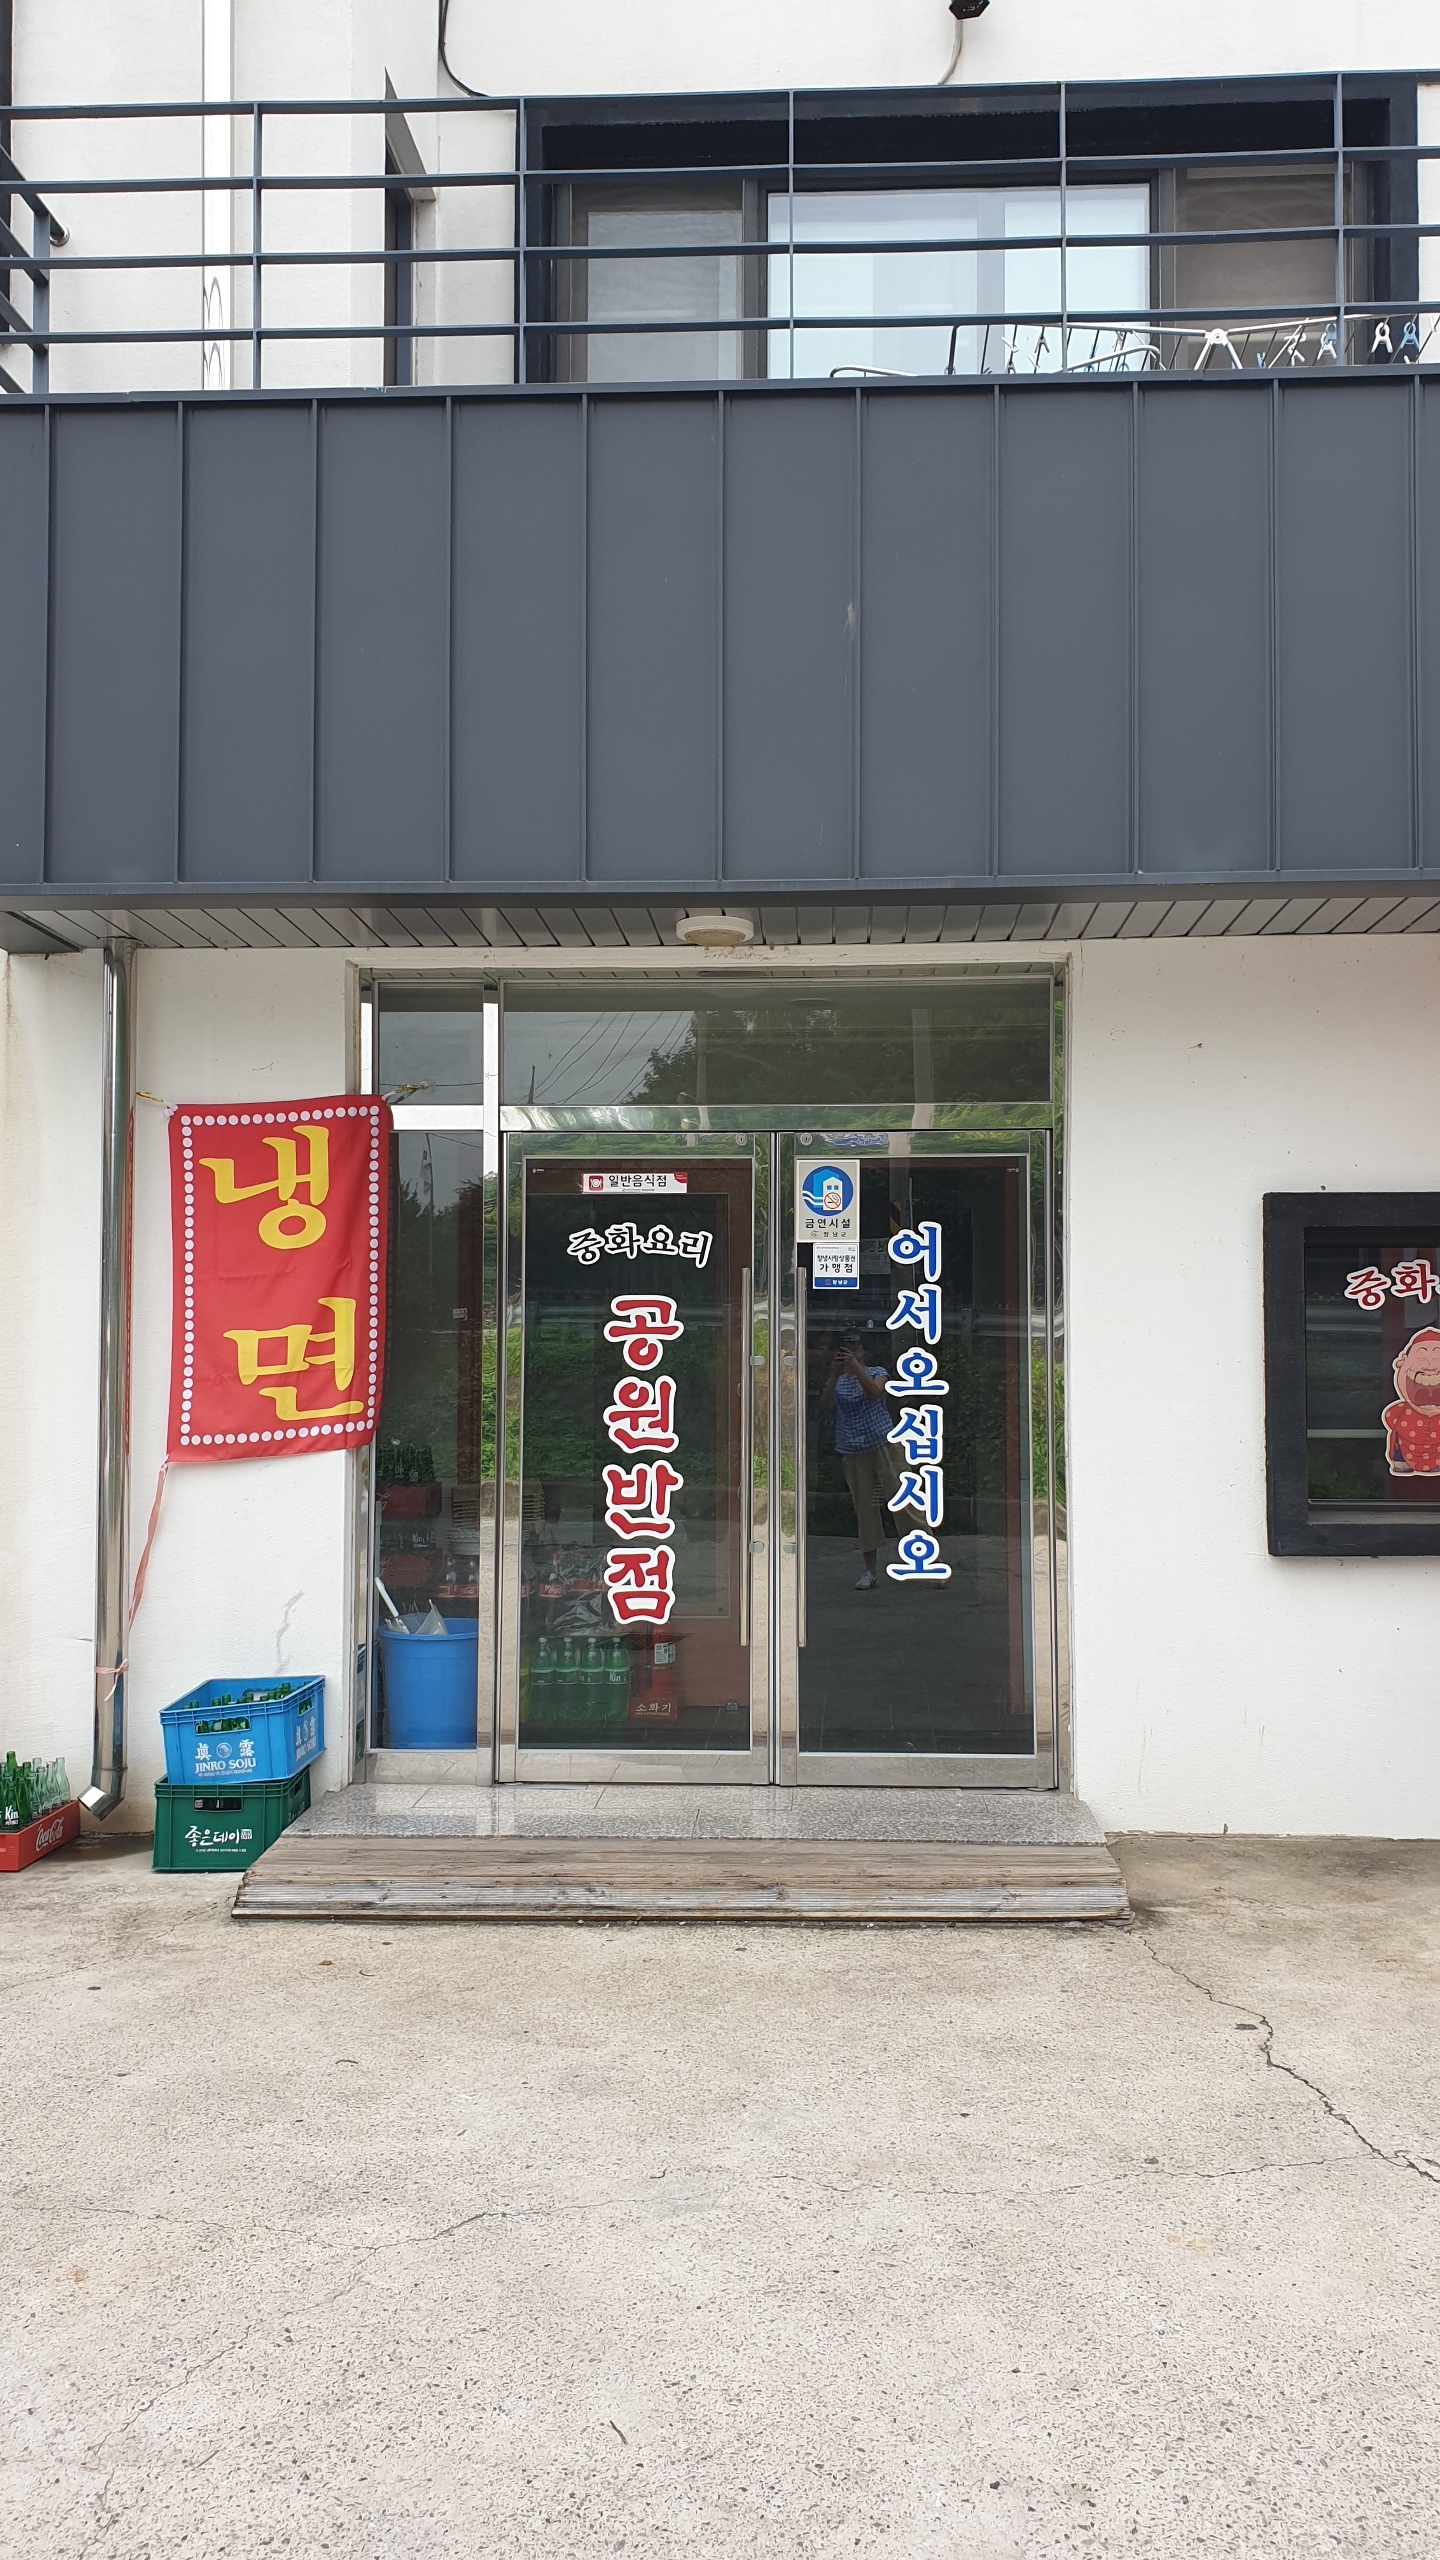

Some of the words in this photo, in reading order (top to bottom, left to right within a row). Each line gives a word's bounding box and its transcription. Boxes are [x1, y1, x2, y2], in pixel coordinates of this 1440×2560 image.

[608, 1174, 668, 1188] 일반음식점
[805, 1218, 851, 1229] 금연시설
[567, 1222, 713, 1268] 중화요리
[198, 1124, 365, 1422] 냉면
[819, 1263, 853, 1273] 가맹점
[1344, 1259, 1440, 1310] 중화
[886, 1222, 951, 1580] 어서오십시오
[604, 1294, 684, 1625] 공원반점
[609, 1671, 621, 1682] Kin
[635, 1703, 671, 1713] 소화기
[194, 1761, 227, 1774] JINRO
[228, 1757, 257, 1769] SOJU
[5, 1805, 19, 1821] Kin
[184, 1825, 240, 1848] 좋은데이
